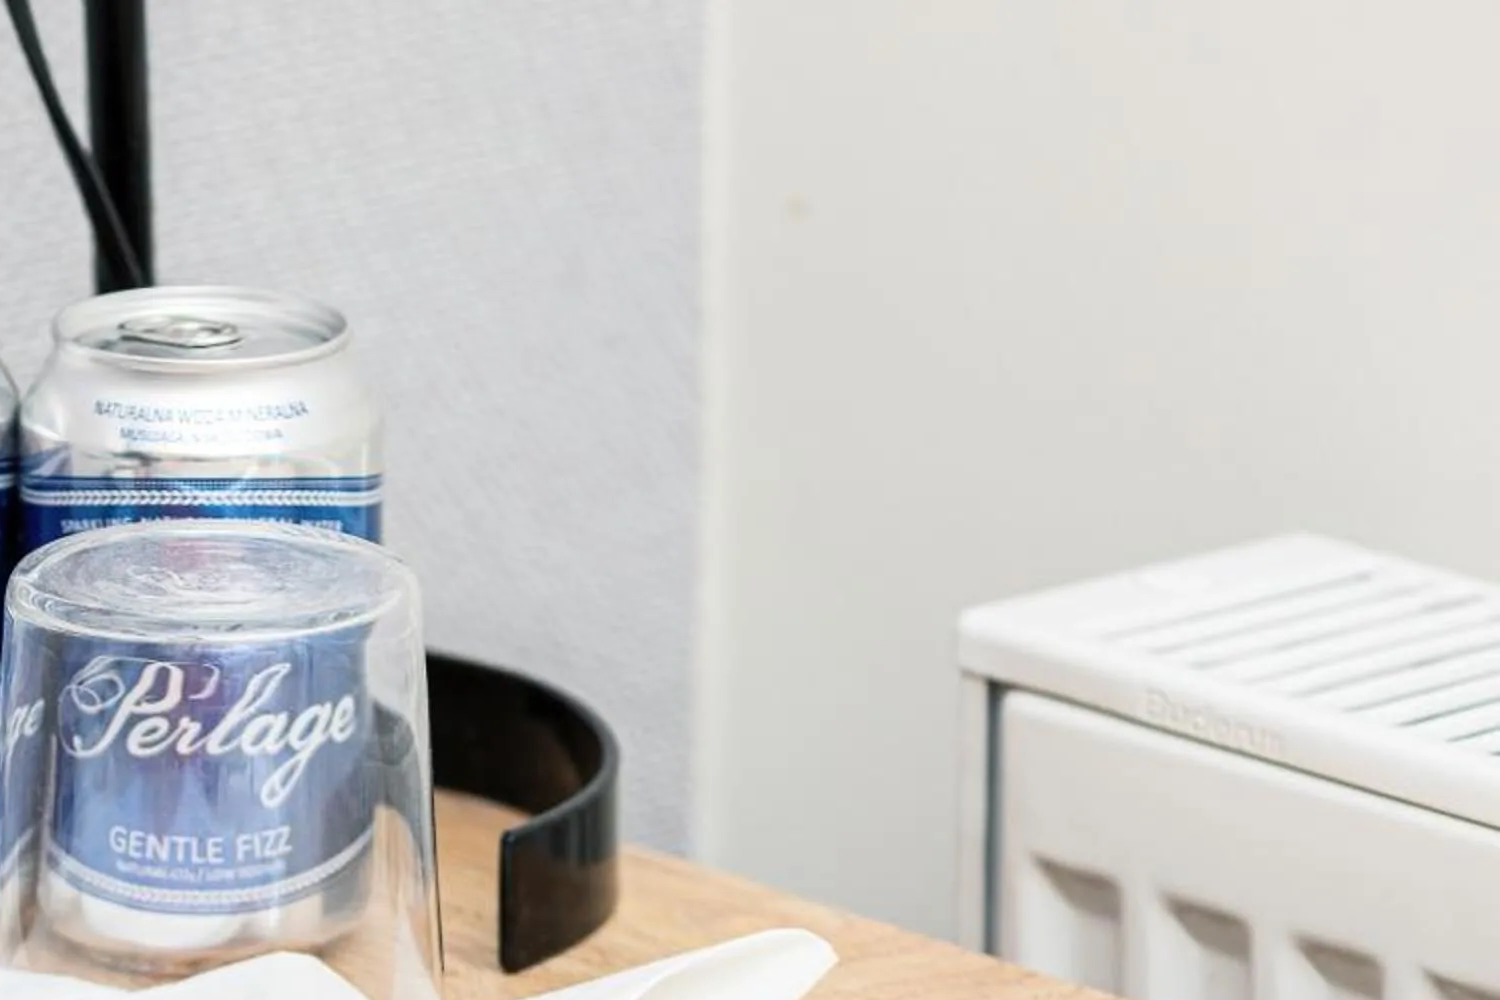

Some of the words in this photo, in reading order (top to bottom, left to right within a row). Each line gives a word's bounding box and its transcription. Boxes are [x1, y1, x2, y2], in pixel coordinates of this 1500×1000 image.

[94, 400, 174, 423] NATURALNA
[57, 655, 356, 809] Perlage
[108, 825, 226, 865] GENTLE
[236, 825, 293, 863] FIZZ
